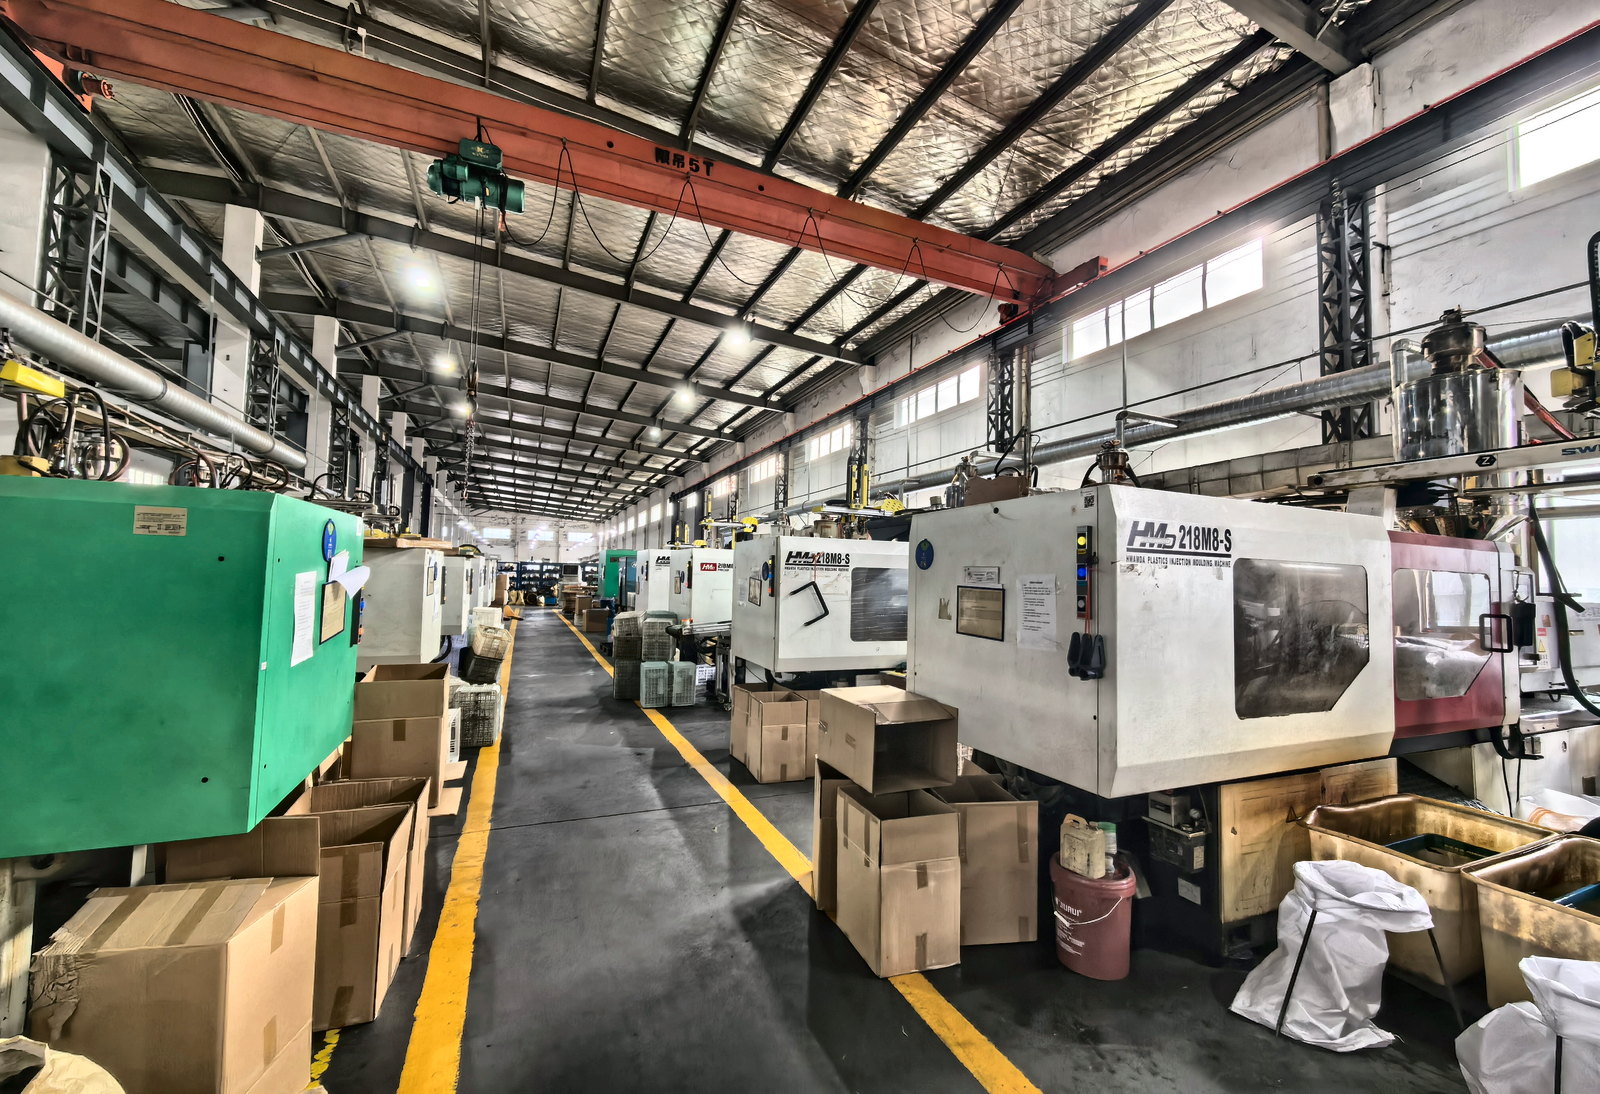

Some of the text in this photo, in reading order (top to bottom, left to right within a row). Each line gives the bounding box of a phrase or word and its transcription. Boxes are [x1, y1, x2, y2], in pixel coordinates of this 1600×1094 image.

[1178, 525, 1232, 552] 218M8-S
[815, 552, 850, 564] 218M8-S
[1147, 557, 1168, 565] PLASTICS
[1169, 558, 1191, 566] INJECTION
[1214, 560, 1231, 568] MACHINE
